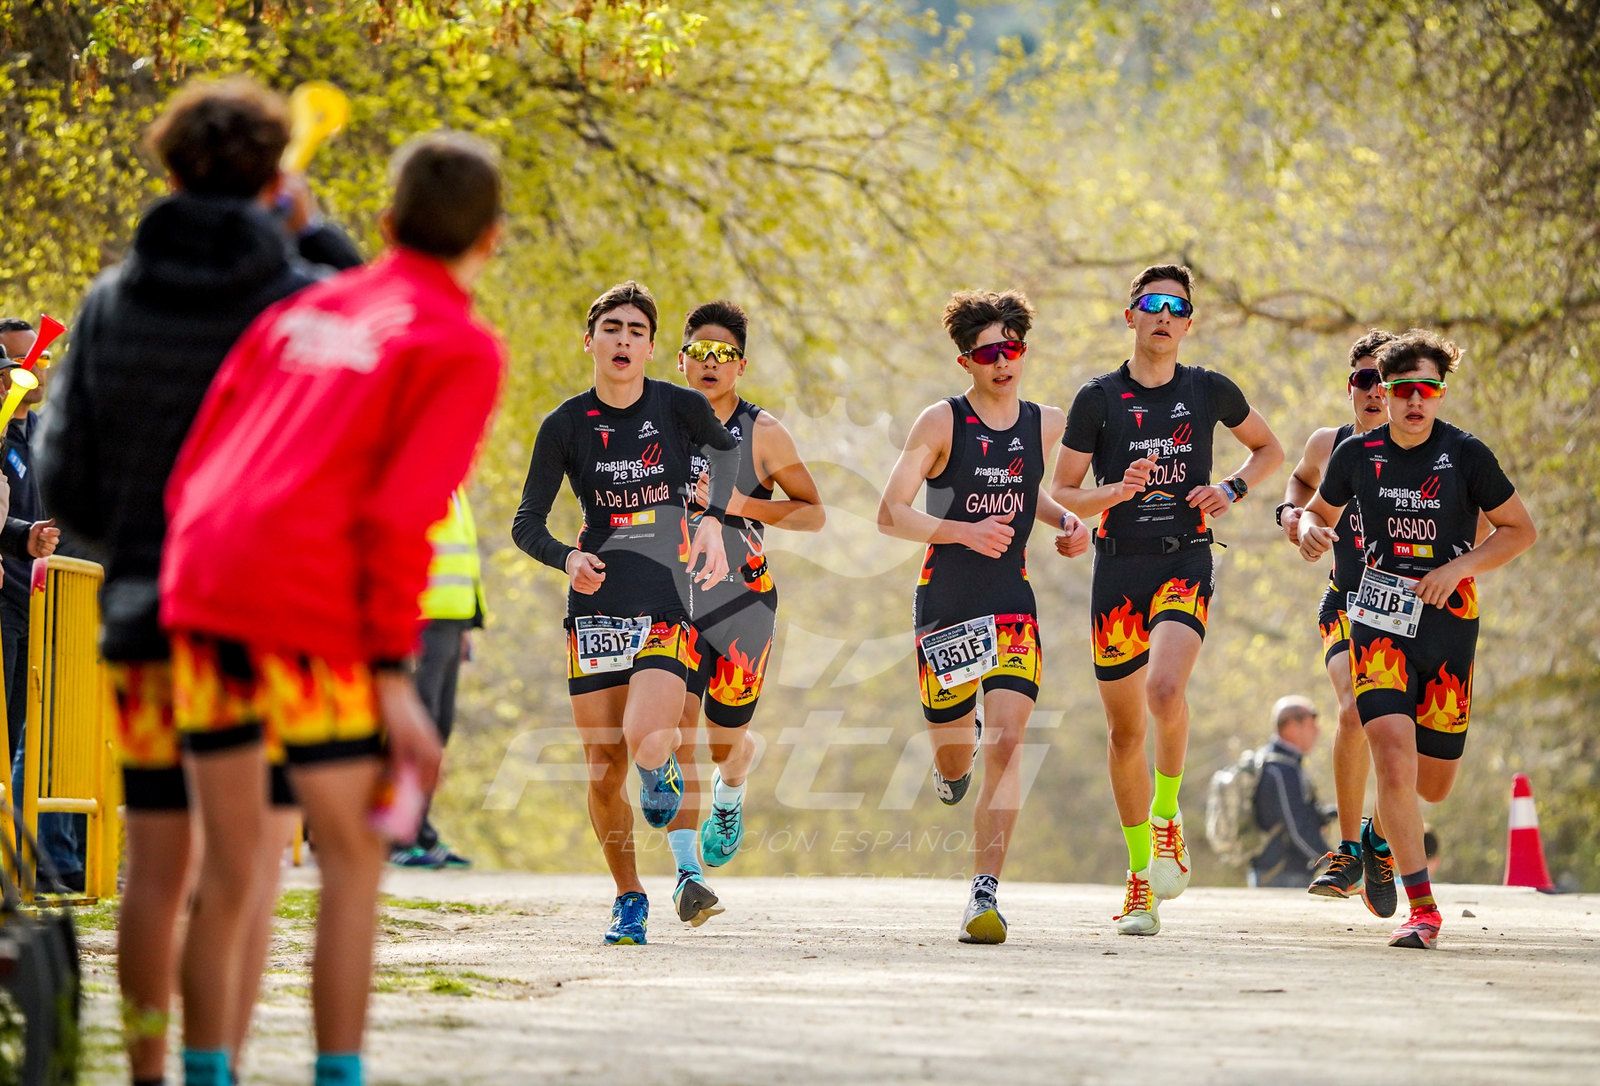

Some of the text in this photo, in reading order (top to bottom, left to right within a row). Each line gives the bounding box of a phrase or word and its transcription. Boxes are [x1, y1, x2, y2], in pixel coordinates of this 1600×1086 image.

[1163, 443, 1192, 456] Rivas
[632, 464, 665, 480] Rivas
[1000, 474, 1023, 484] Rivas
[595, 490, 606, 507] A.
[606, 490, 623, 508] De
[625, 490, 639, 508] La
[641, 482, 670, 505] Viuda
[965, 488, 1025, 513] GAMÓN
[1411, 498, 1441, 509] Rivas
[613, 516, 629, 524] TM
[1387, 517, 1437, 541] CASADO
[1396, 545, 1410, 553] TM
[1360, 585, 1401, 613] 1351B
[928, 637, 983, 674] 1351E
